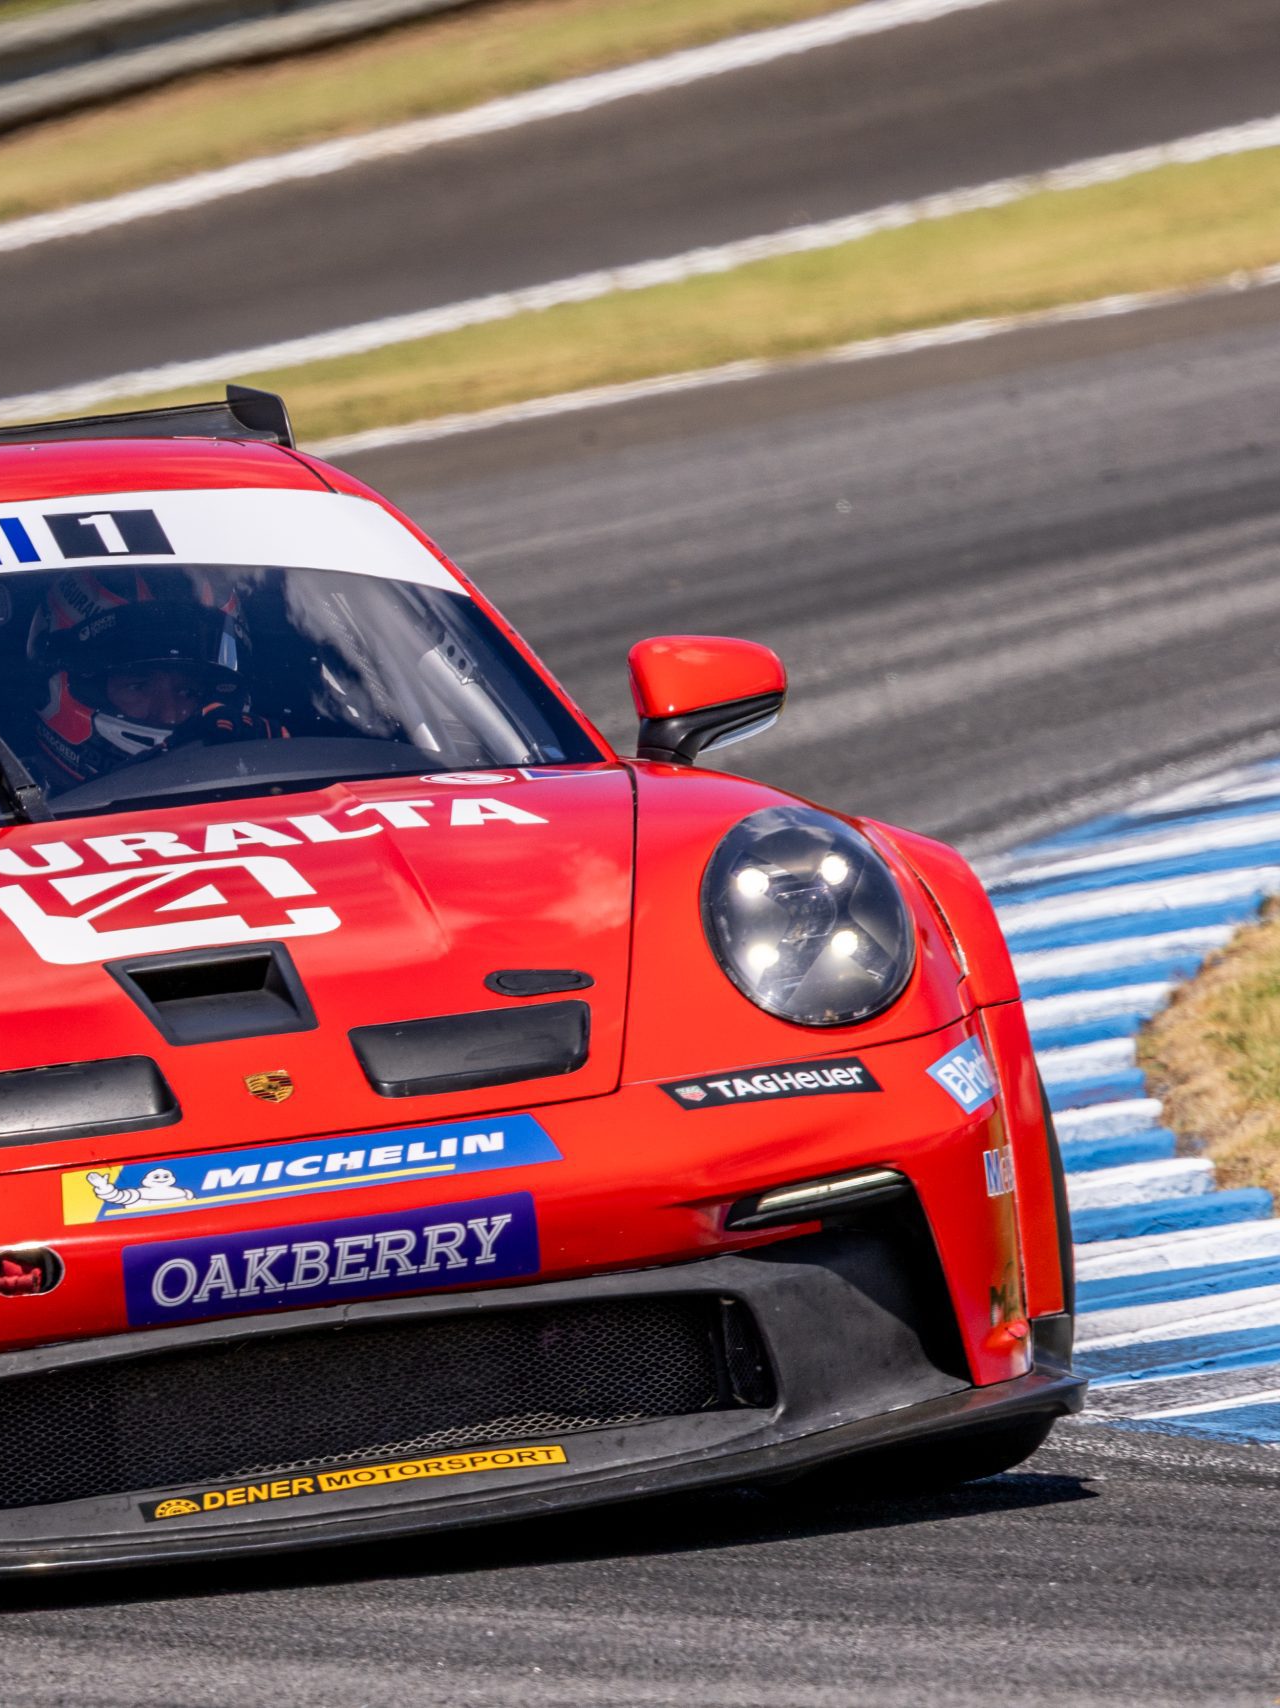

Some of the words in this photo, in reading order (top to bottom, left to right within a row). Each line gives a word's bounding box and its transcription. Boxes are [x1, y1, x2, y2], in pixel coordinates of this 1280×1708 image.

[75, 513, 128, 554] 1
[201, 1131, 505, 1191] MICHELIN
[151, 1213, 513, 1307] OAKBERRY
[202, 1476, 316, 1511] DENER
[325, 1448, 558, 1489] MOTORSPORT
